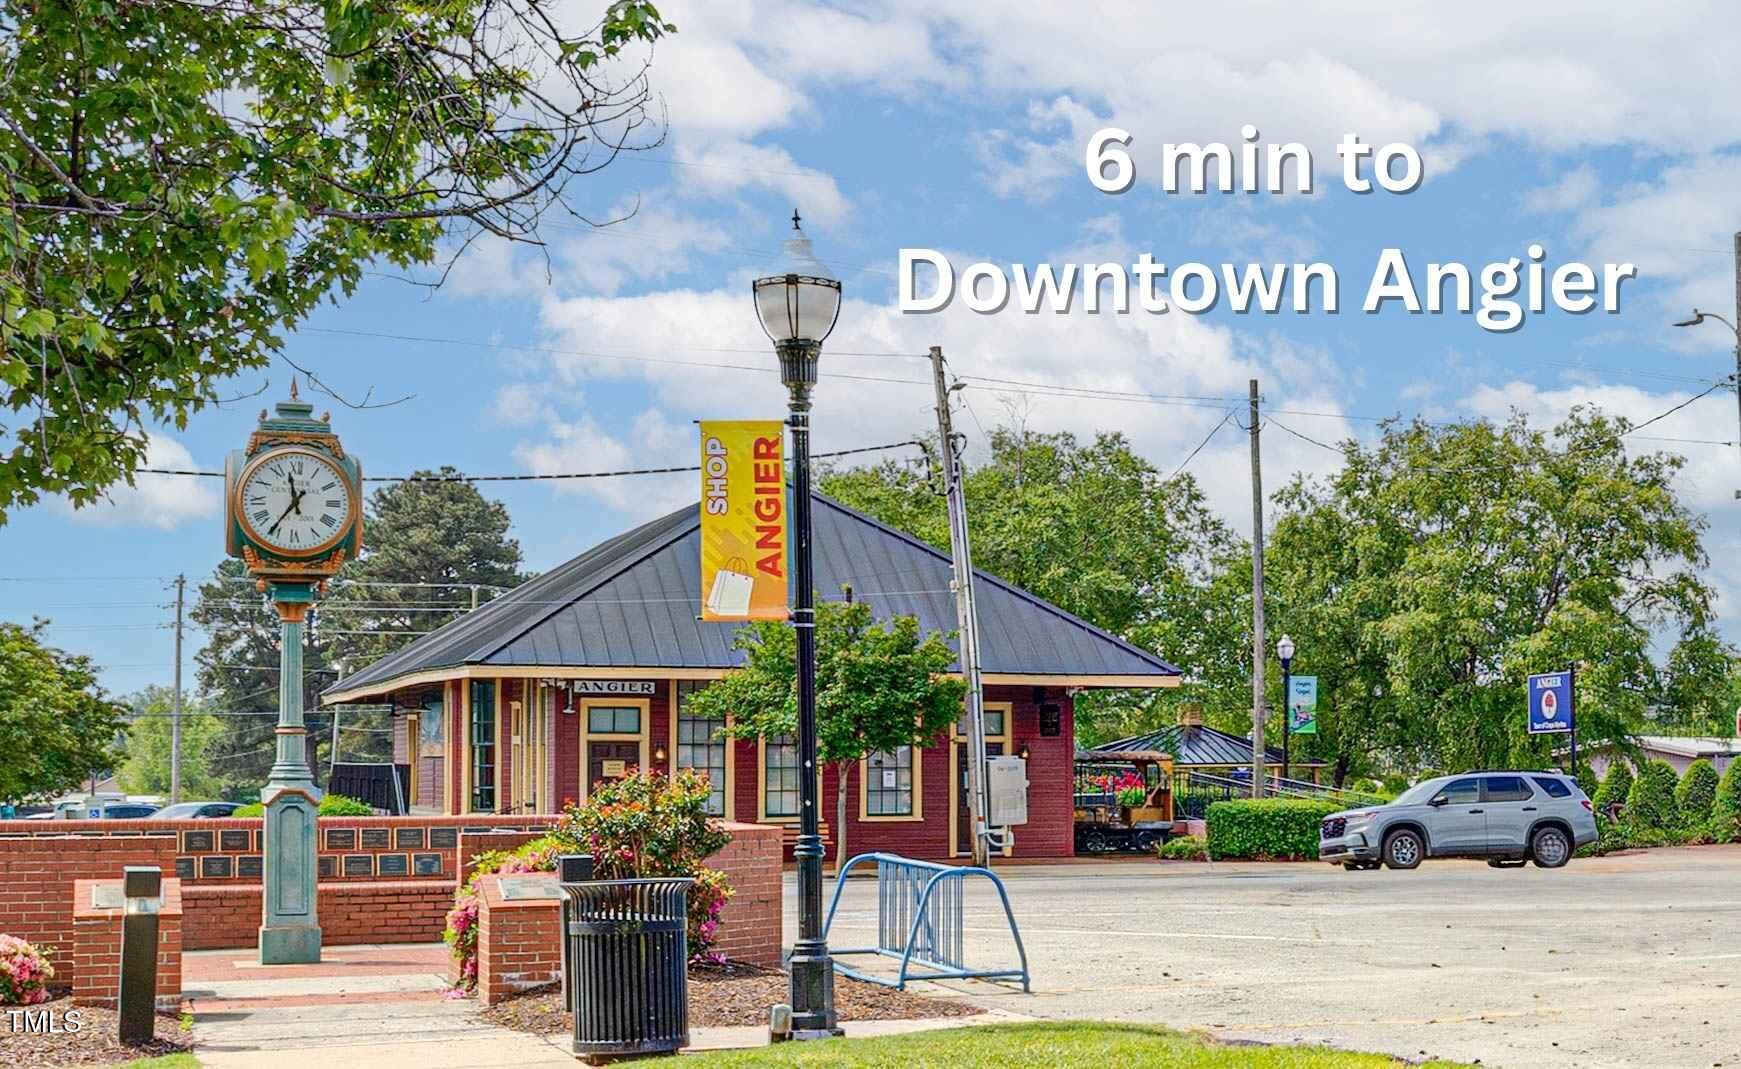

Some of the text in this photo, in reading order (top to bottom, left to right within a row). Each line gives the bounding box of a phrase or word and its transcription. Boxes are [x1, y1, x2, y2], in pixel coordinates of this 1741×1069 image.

[706, 437, 728, 516] SHOP
[753, 436, 784, 578] ANGIER
[578, 681, 653, 693] ANGIER
